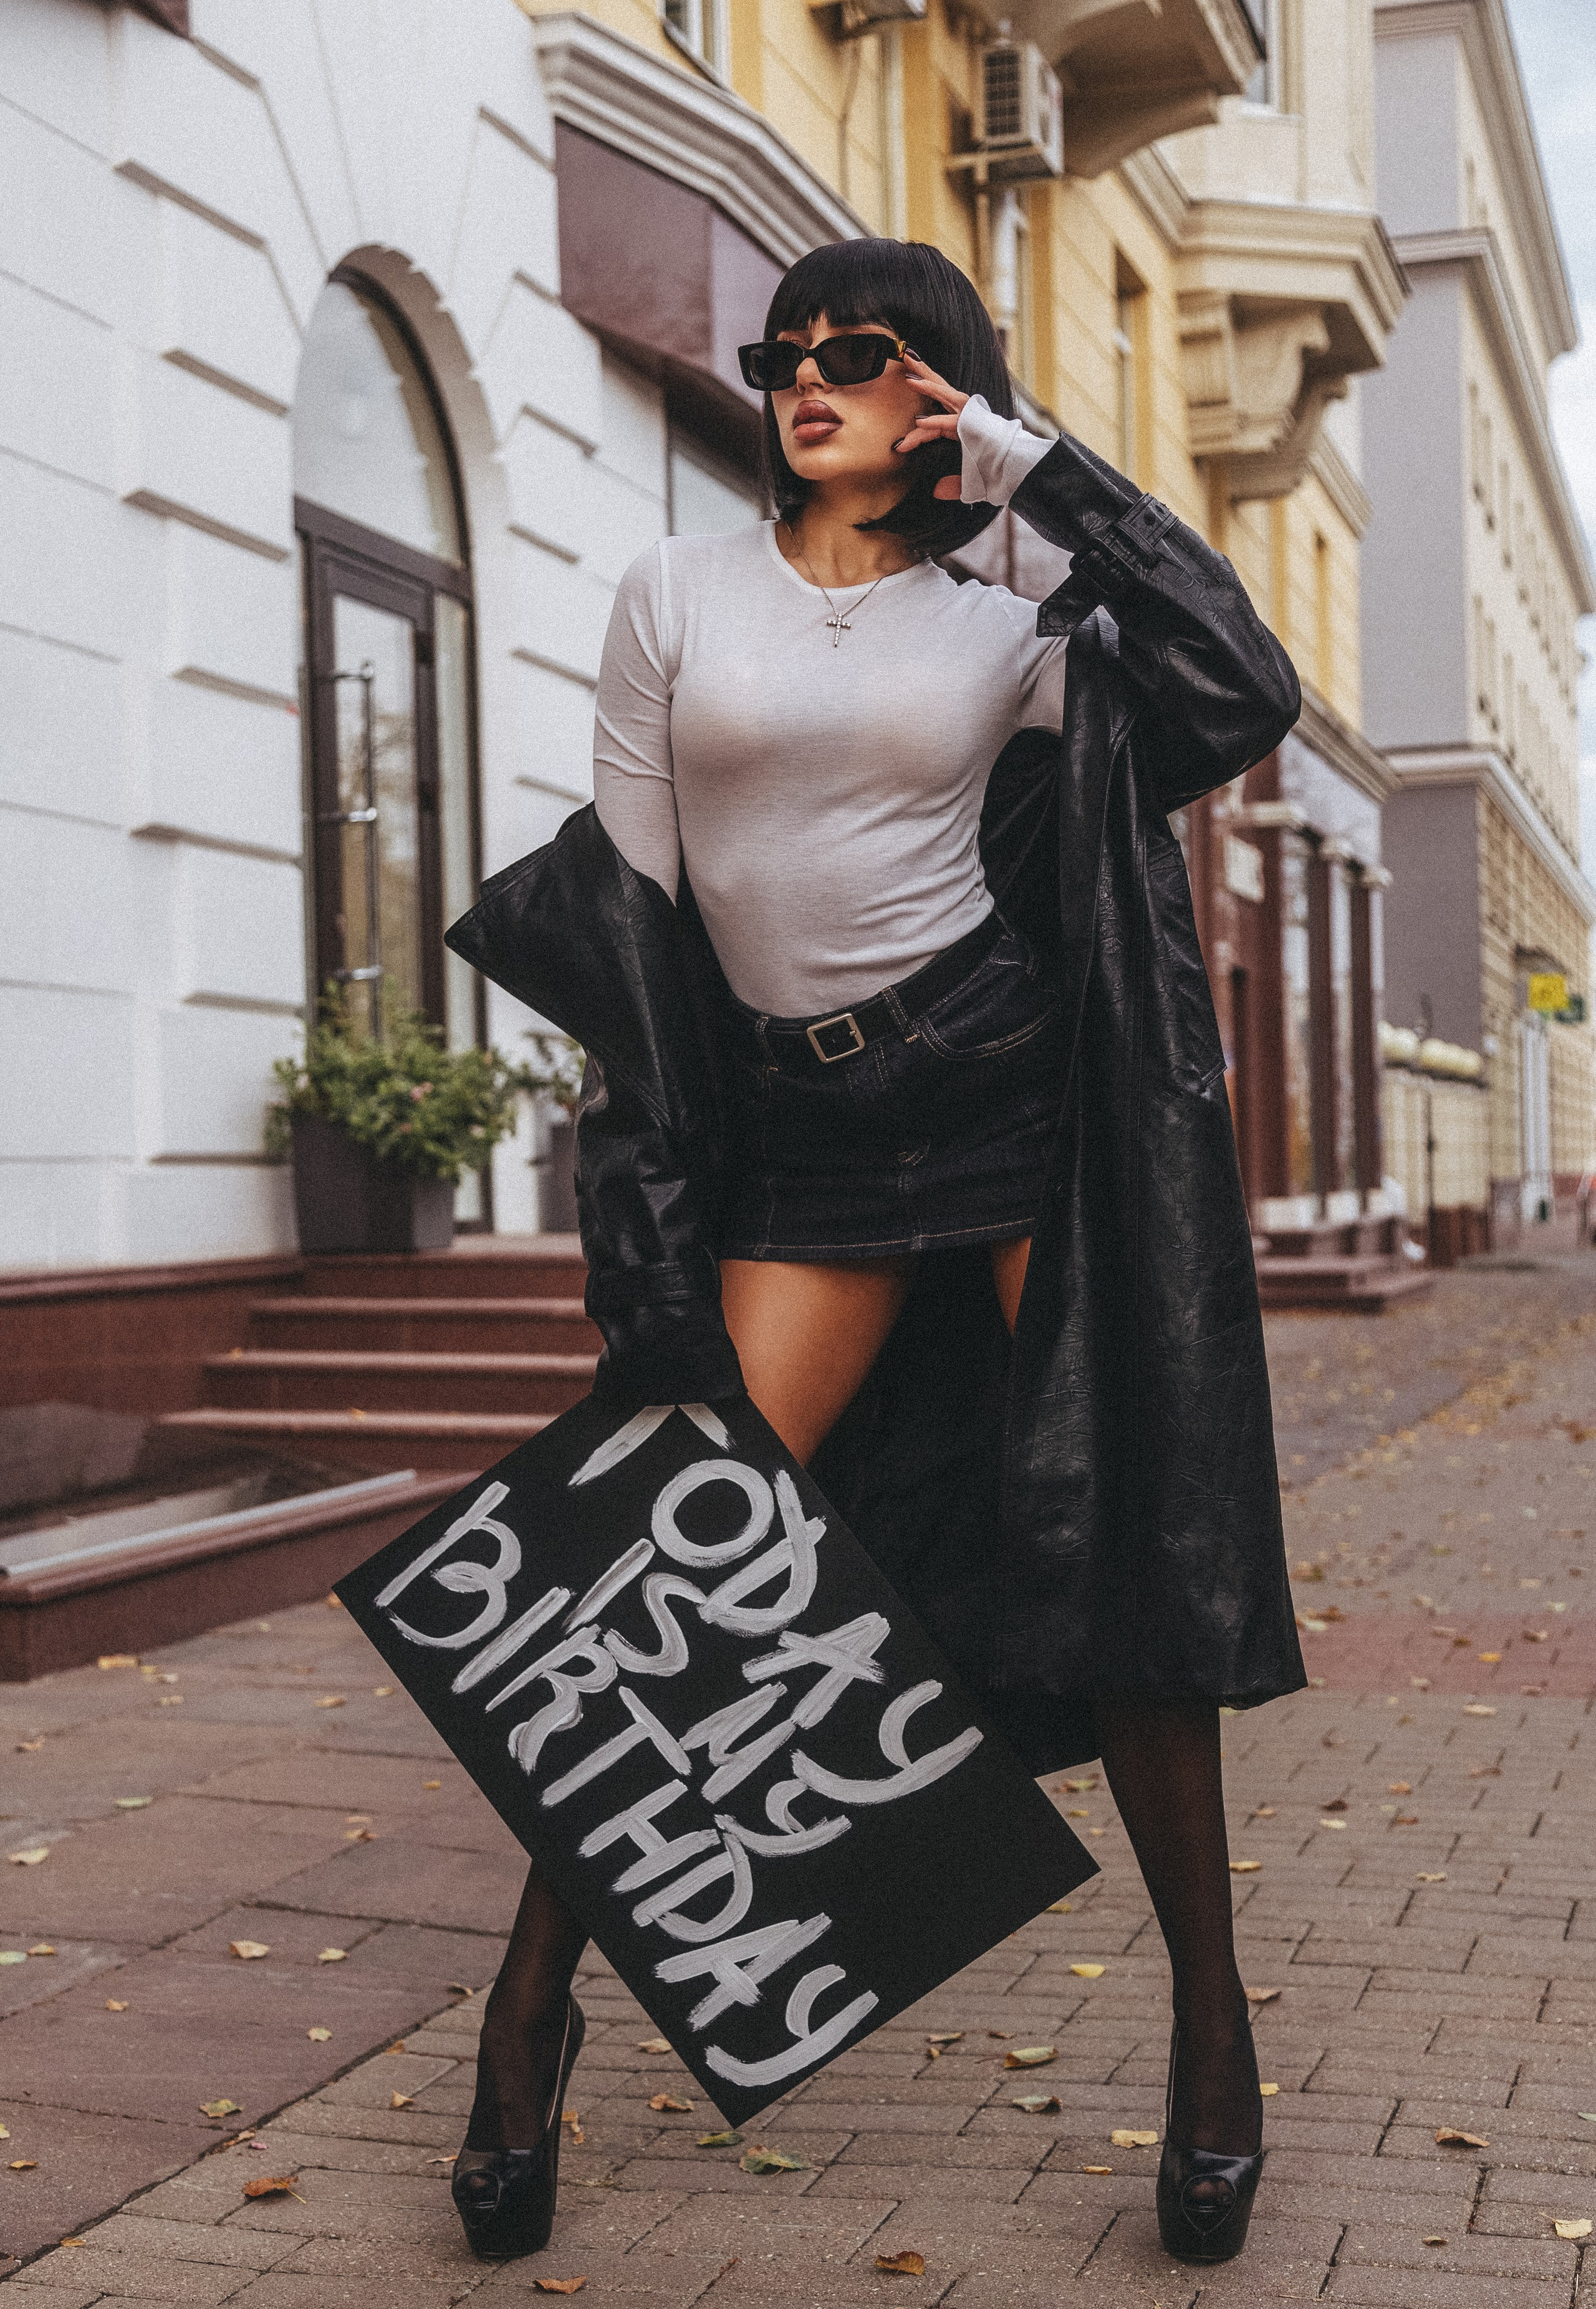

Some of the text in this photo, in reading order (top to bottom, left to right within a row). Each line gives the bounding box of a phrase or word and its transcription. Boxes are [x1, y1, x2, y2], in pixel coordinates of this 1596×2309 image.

[375, 1481, 880, 2088] BIRTHDAY
[564, 1538, 852, 1858] IS MY
